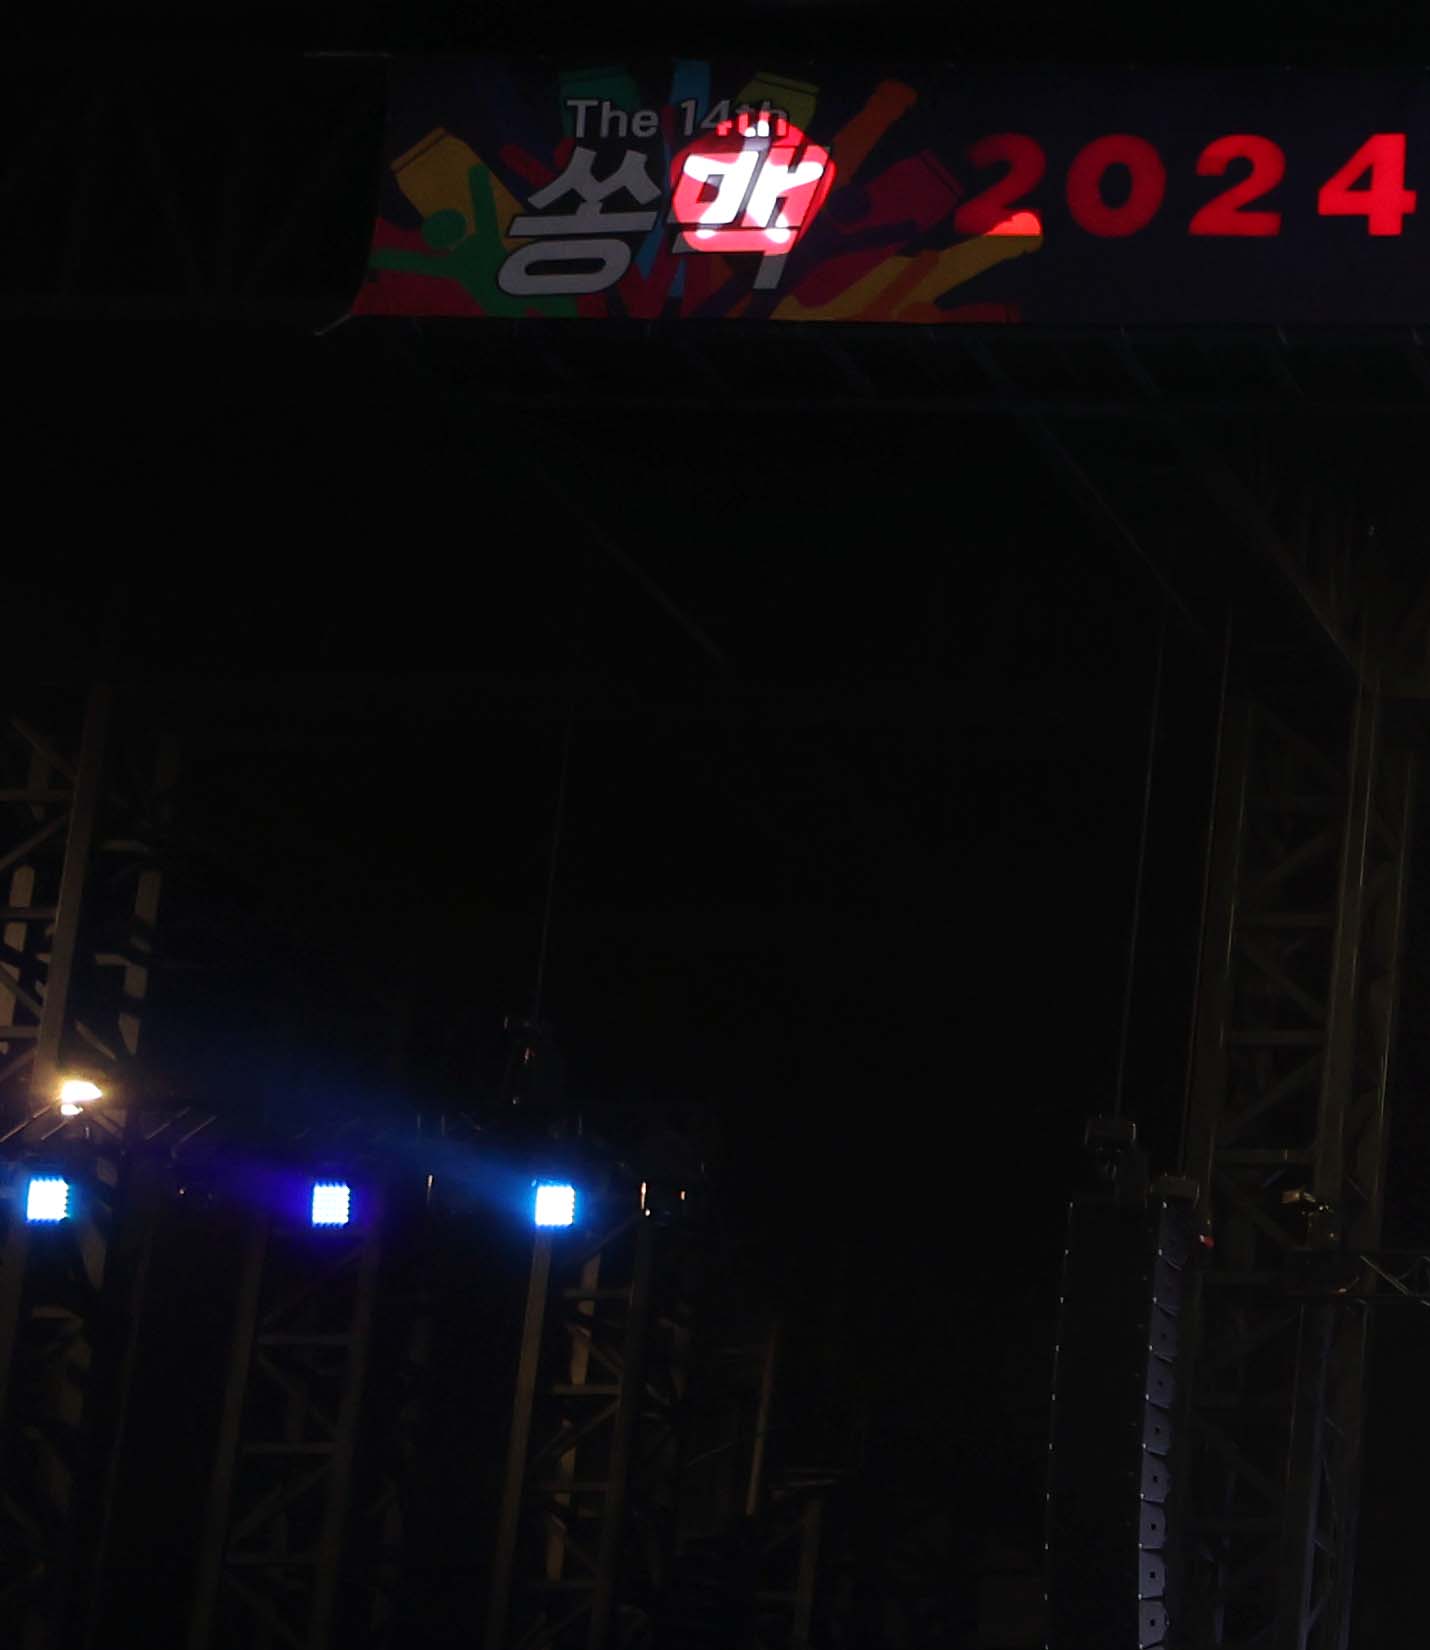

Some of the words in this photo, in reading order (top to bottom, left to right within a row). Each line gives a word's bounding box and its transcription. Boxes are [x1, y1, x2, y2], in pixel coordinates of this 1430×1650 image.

[566, 99, 660, 139] The
[679, 98, 789, 138] 14th
[954, 131, 1417, 239] 2024
